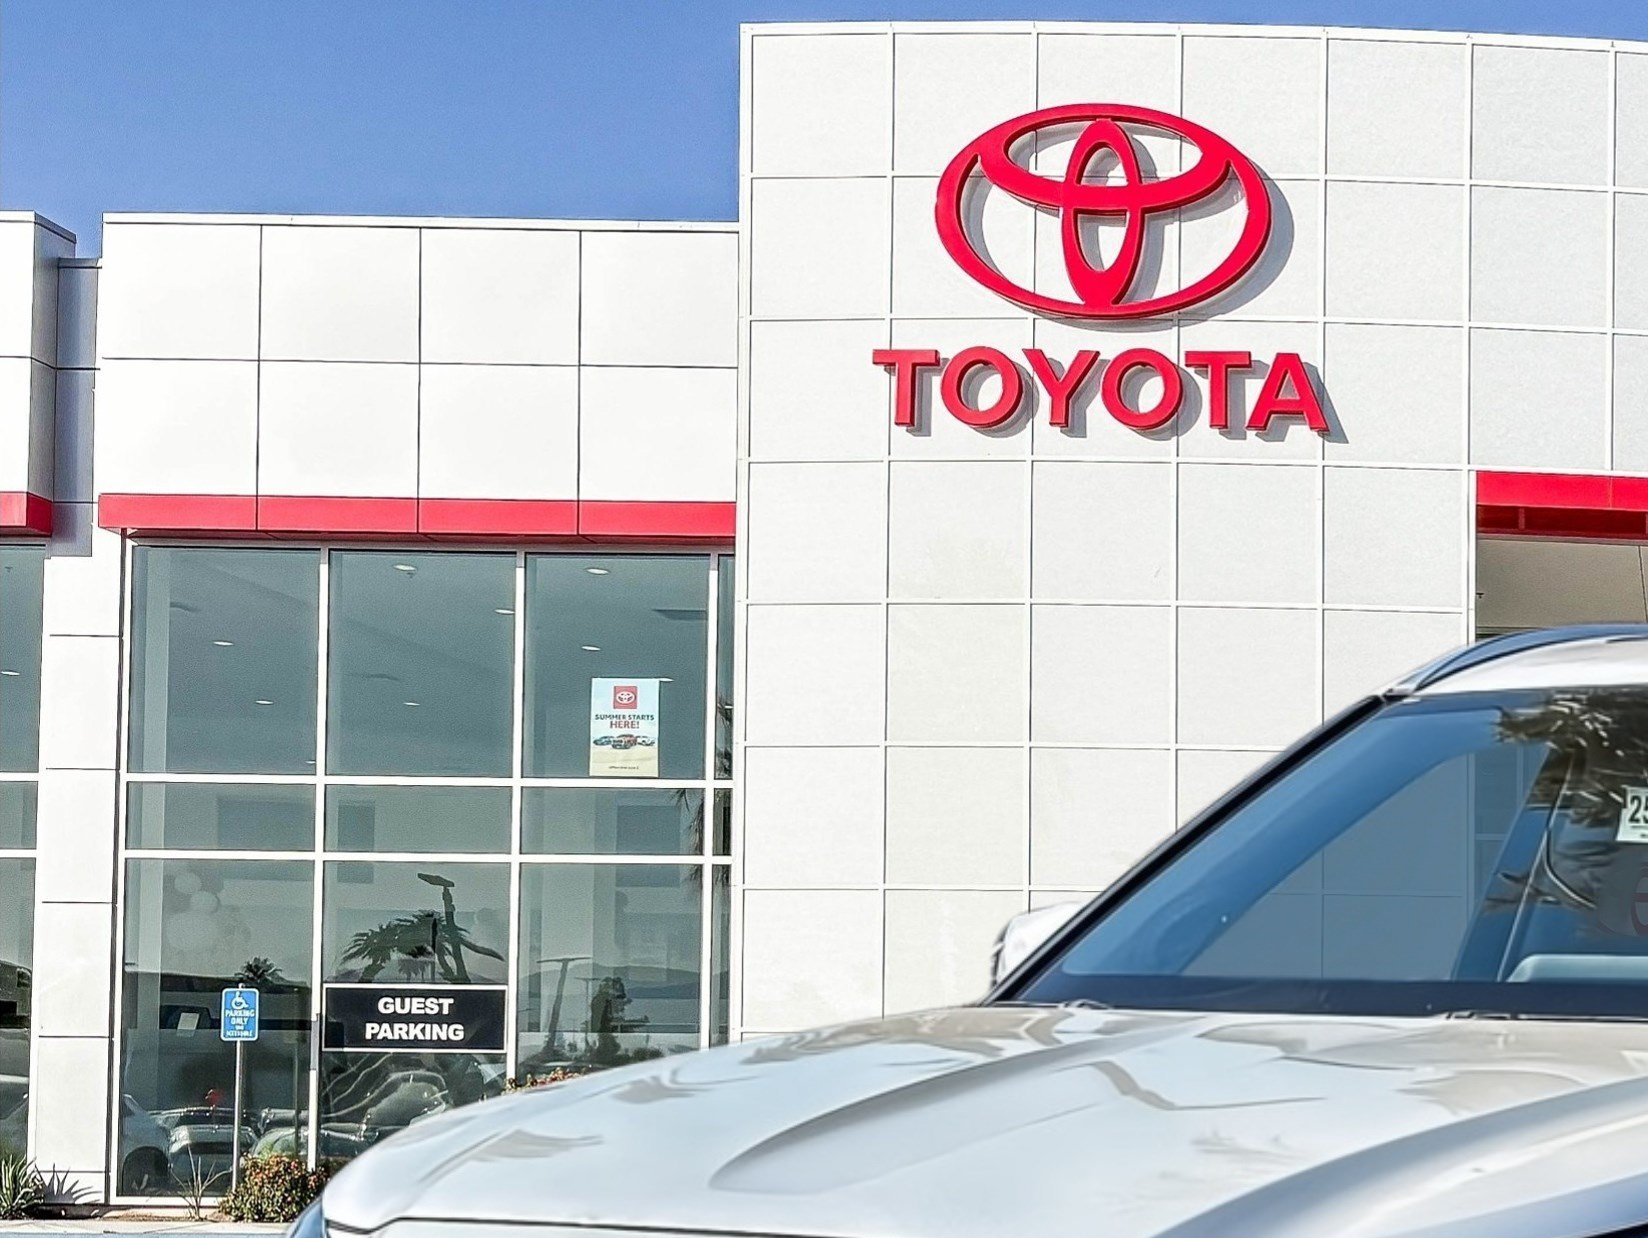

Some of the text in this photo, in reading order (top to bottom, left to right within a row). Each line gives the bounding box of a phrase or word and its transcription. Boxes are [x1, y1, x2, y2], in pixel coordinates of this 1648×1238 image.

[872, 346, 1329, 432] TOYOTA
[610, 720, 640, 729] HERE!
[378, 996, 454, 1015] GUEST
[365, 1022, 465, 1041] PARKING
